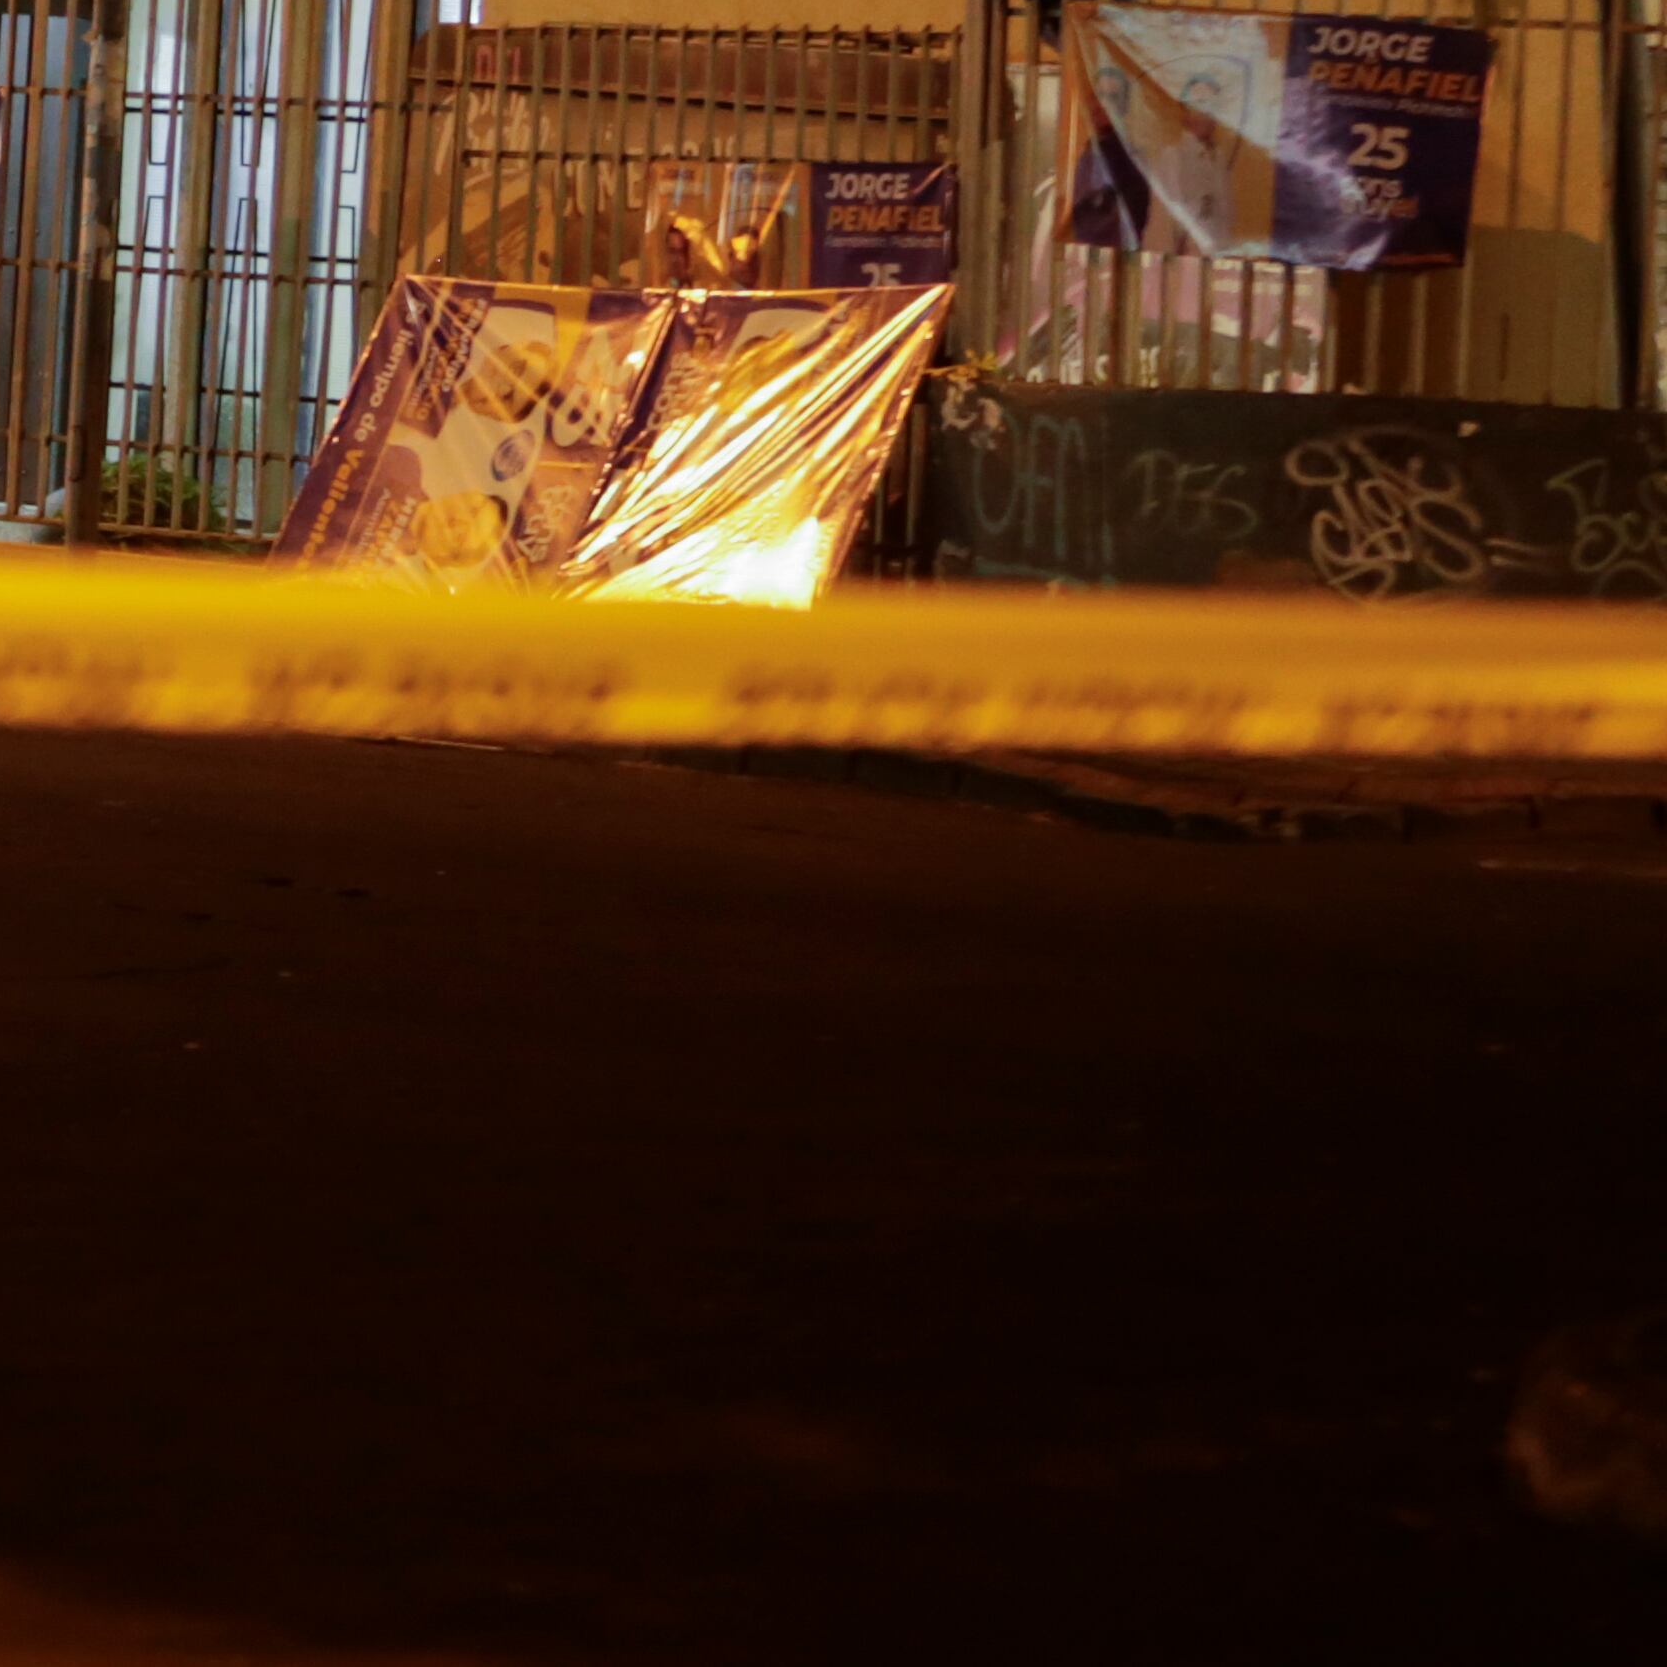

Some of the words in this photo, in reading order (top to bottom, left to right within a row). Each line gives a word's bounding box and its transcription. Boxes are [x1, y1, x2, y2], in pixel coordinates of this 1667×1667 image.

[1307, 26, 1435, 63] JORGE
[1308, 56, 1480, 102] PEÑAFIEL
[1348, 122, 1411, 171] 25
[825, 173, 910, 200] JORGE
[370, 329, 414, 407] tiempo
[355, 412, 376, 442] de
